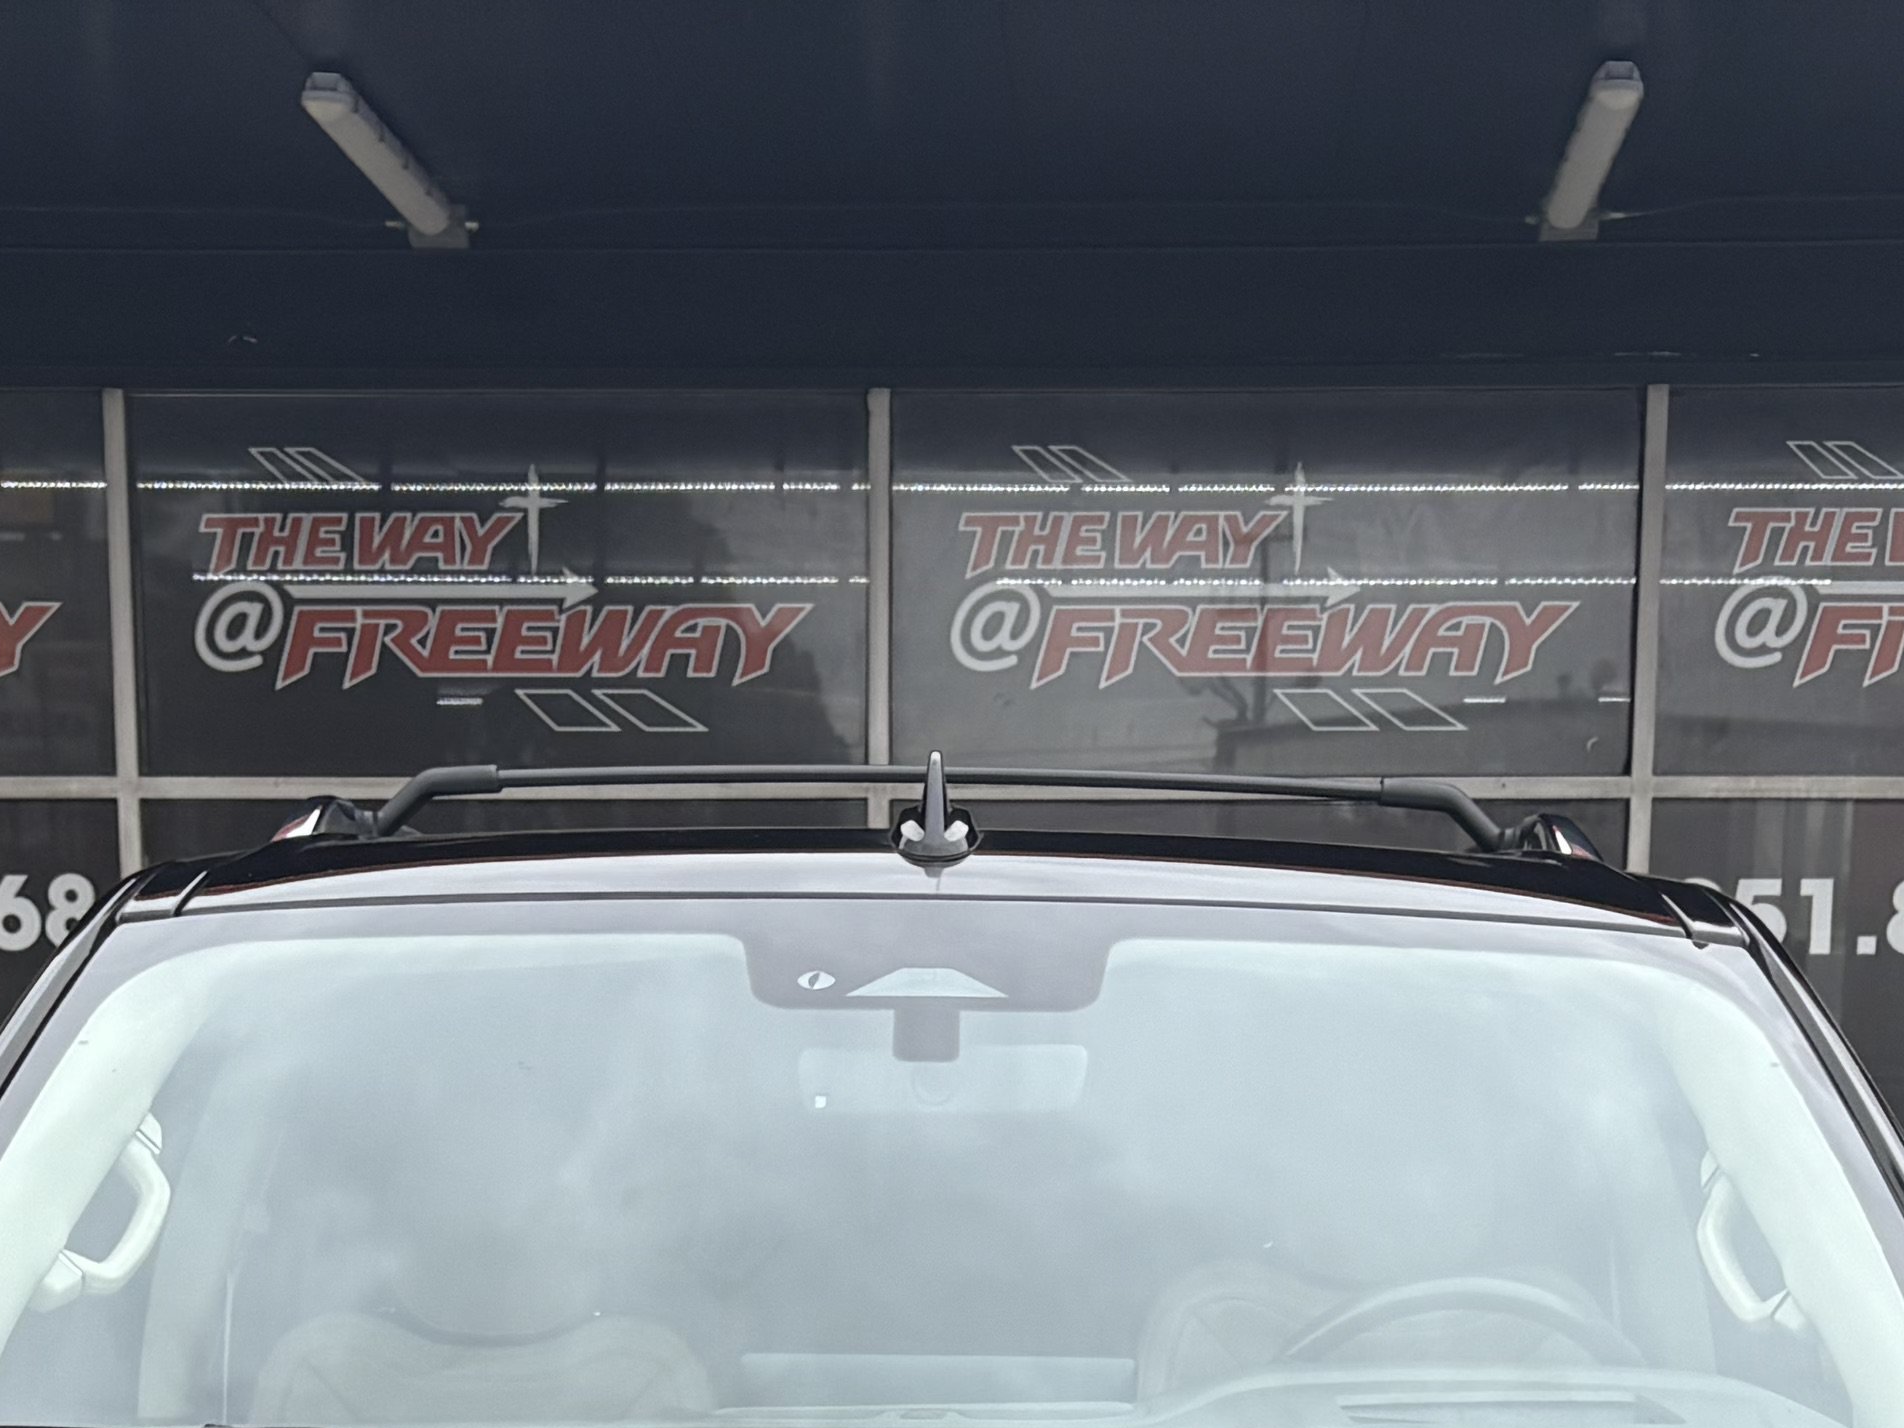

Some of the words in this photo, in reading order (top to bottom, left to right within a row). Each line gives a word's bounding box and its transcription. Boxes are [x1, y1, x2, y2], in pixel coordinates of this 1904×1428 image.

[199, 511, 347, 574] THE
[353, 511, 523, 571] WAY
[958, 510, 1109, 577] THE
[1114, 509, 1289, 570] WAY
[1728, 506, 1878, 575] THE
